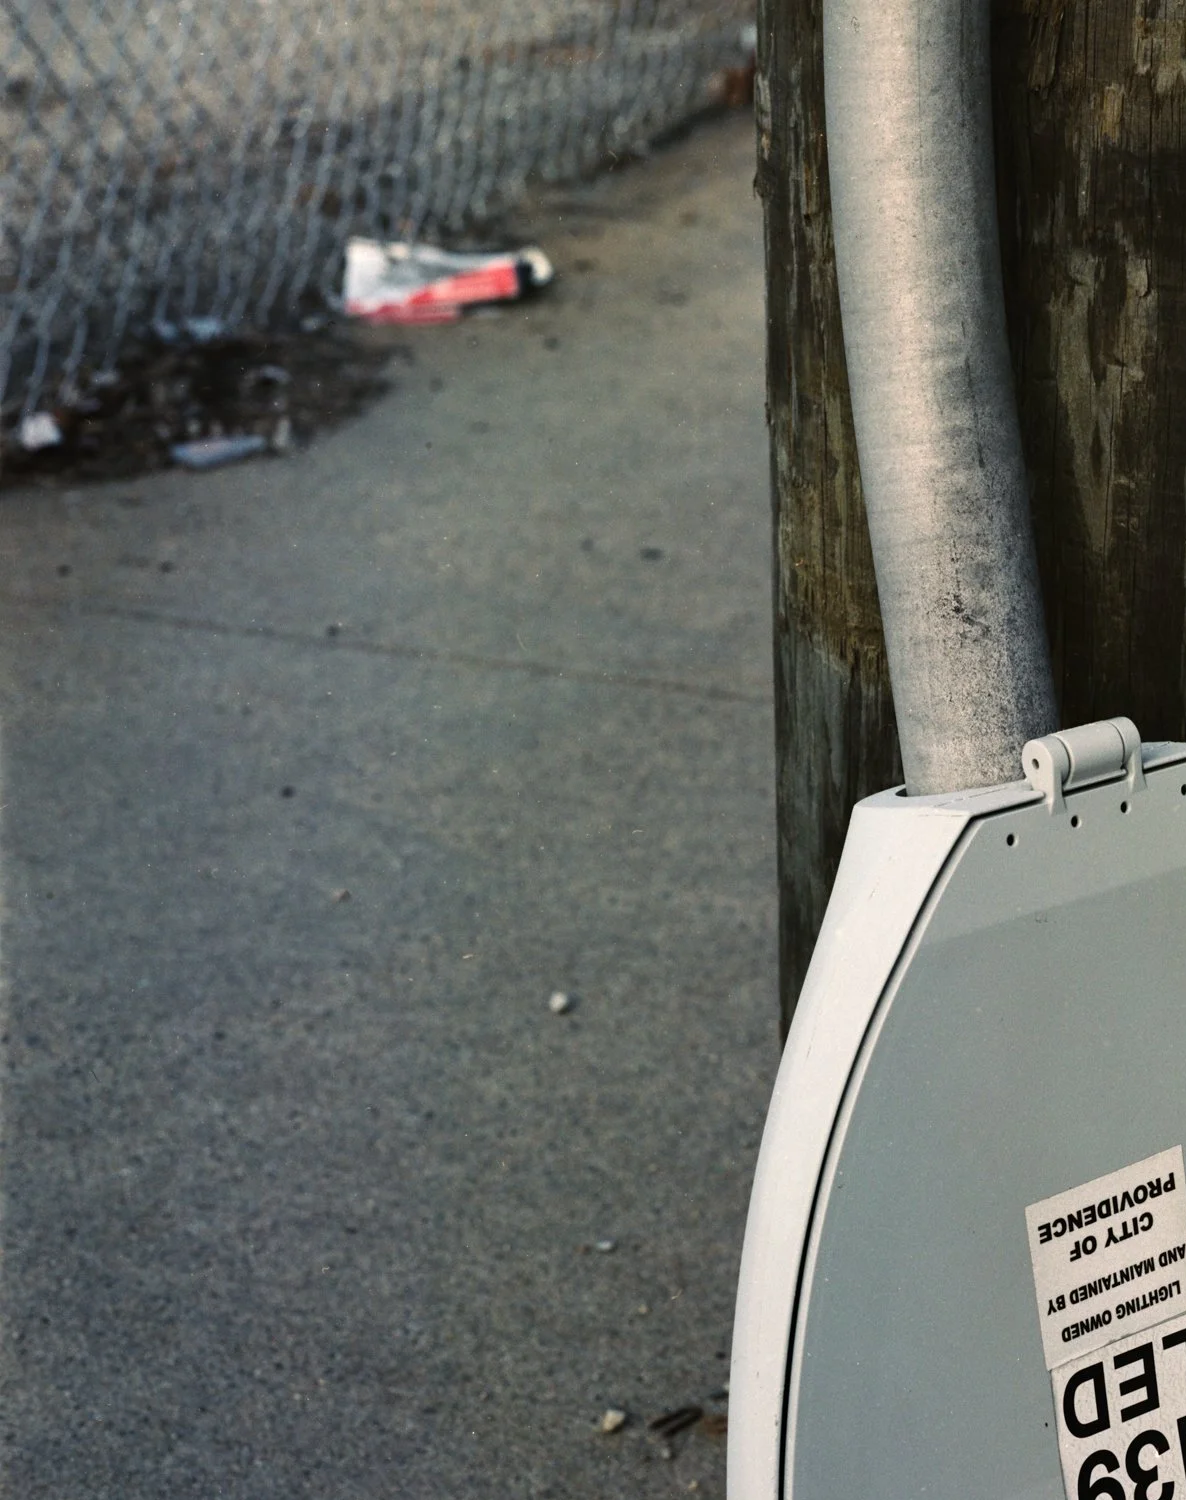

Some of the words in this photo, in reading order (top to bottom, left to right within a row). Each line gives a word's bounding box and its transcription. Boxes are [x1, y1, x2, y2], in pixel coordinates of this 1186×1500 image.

[1037, 1171, 1176, 1245] PROVIDENCE
[1104, 1211, 1154, 1249] CITY
[1069, 1235, 1098, 1263] OF
[1158, 1243, 1186, 1268] AND
[1069, 1256, 1156, 1305] MAINTAINED
[1047, 1294, 1067, 1316] BY
[1115, 1279, 1182, 1320] LIGHTING
[1061, 1309, 1113, 1343] OWNED
